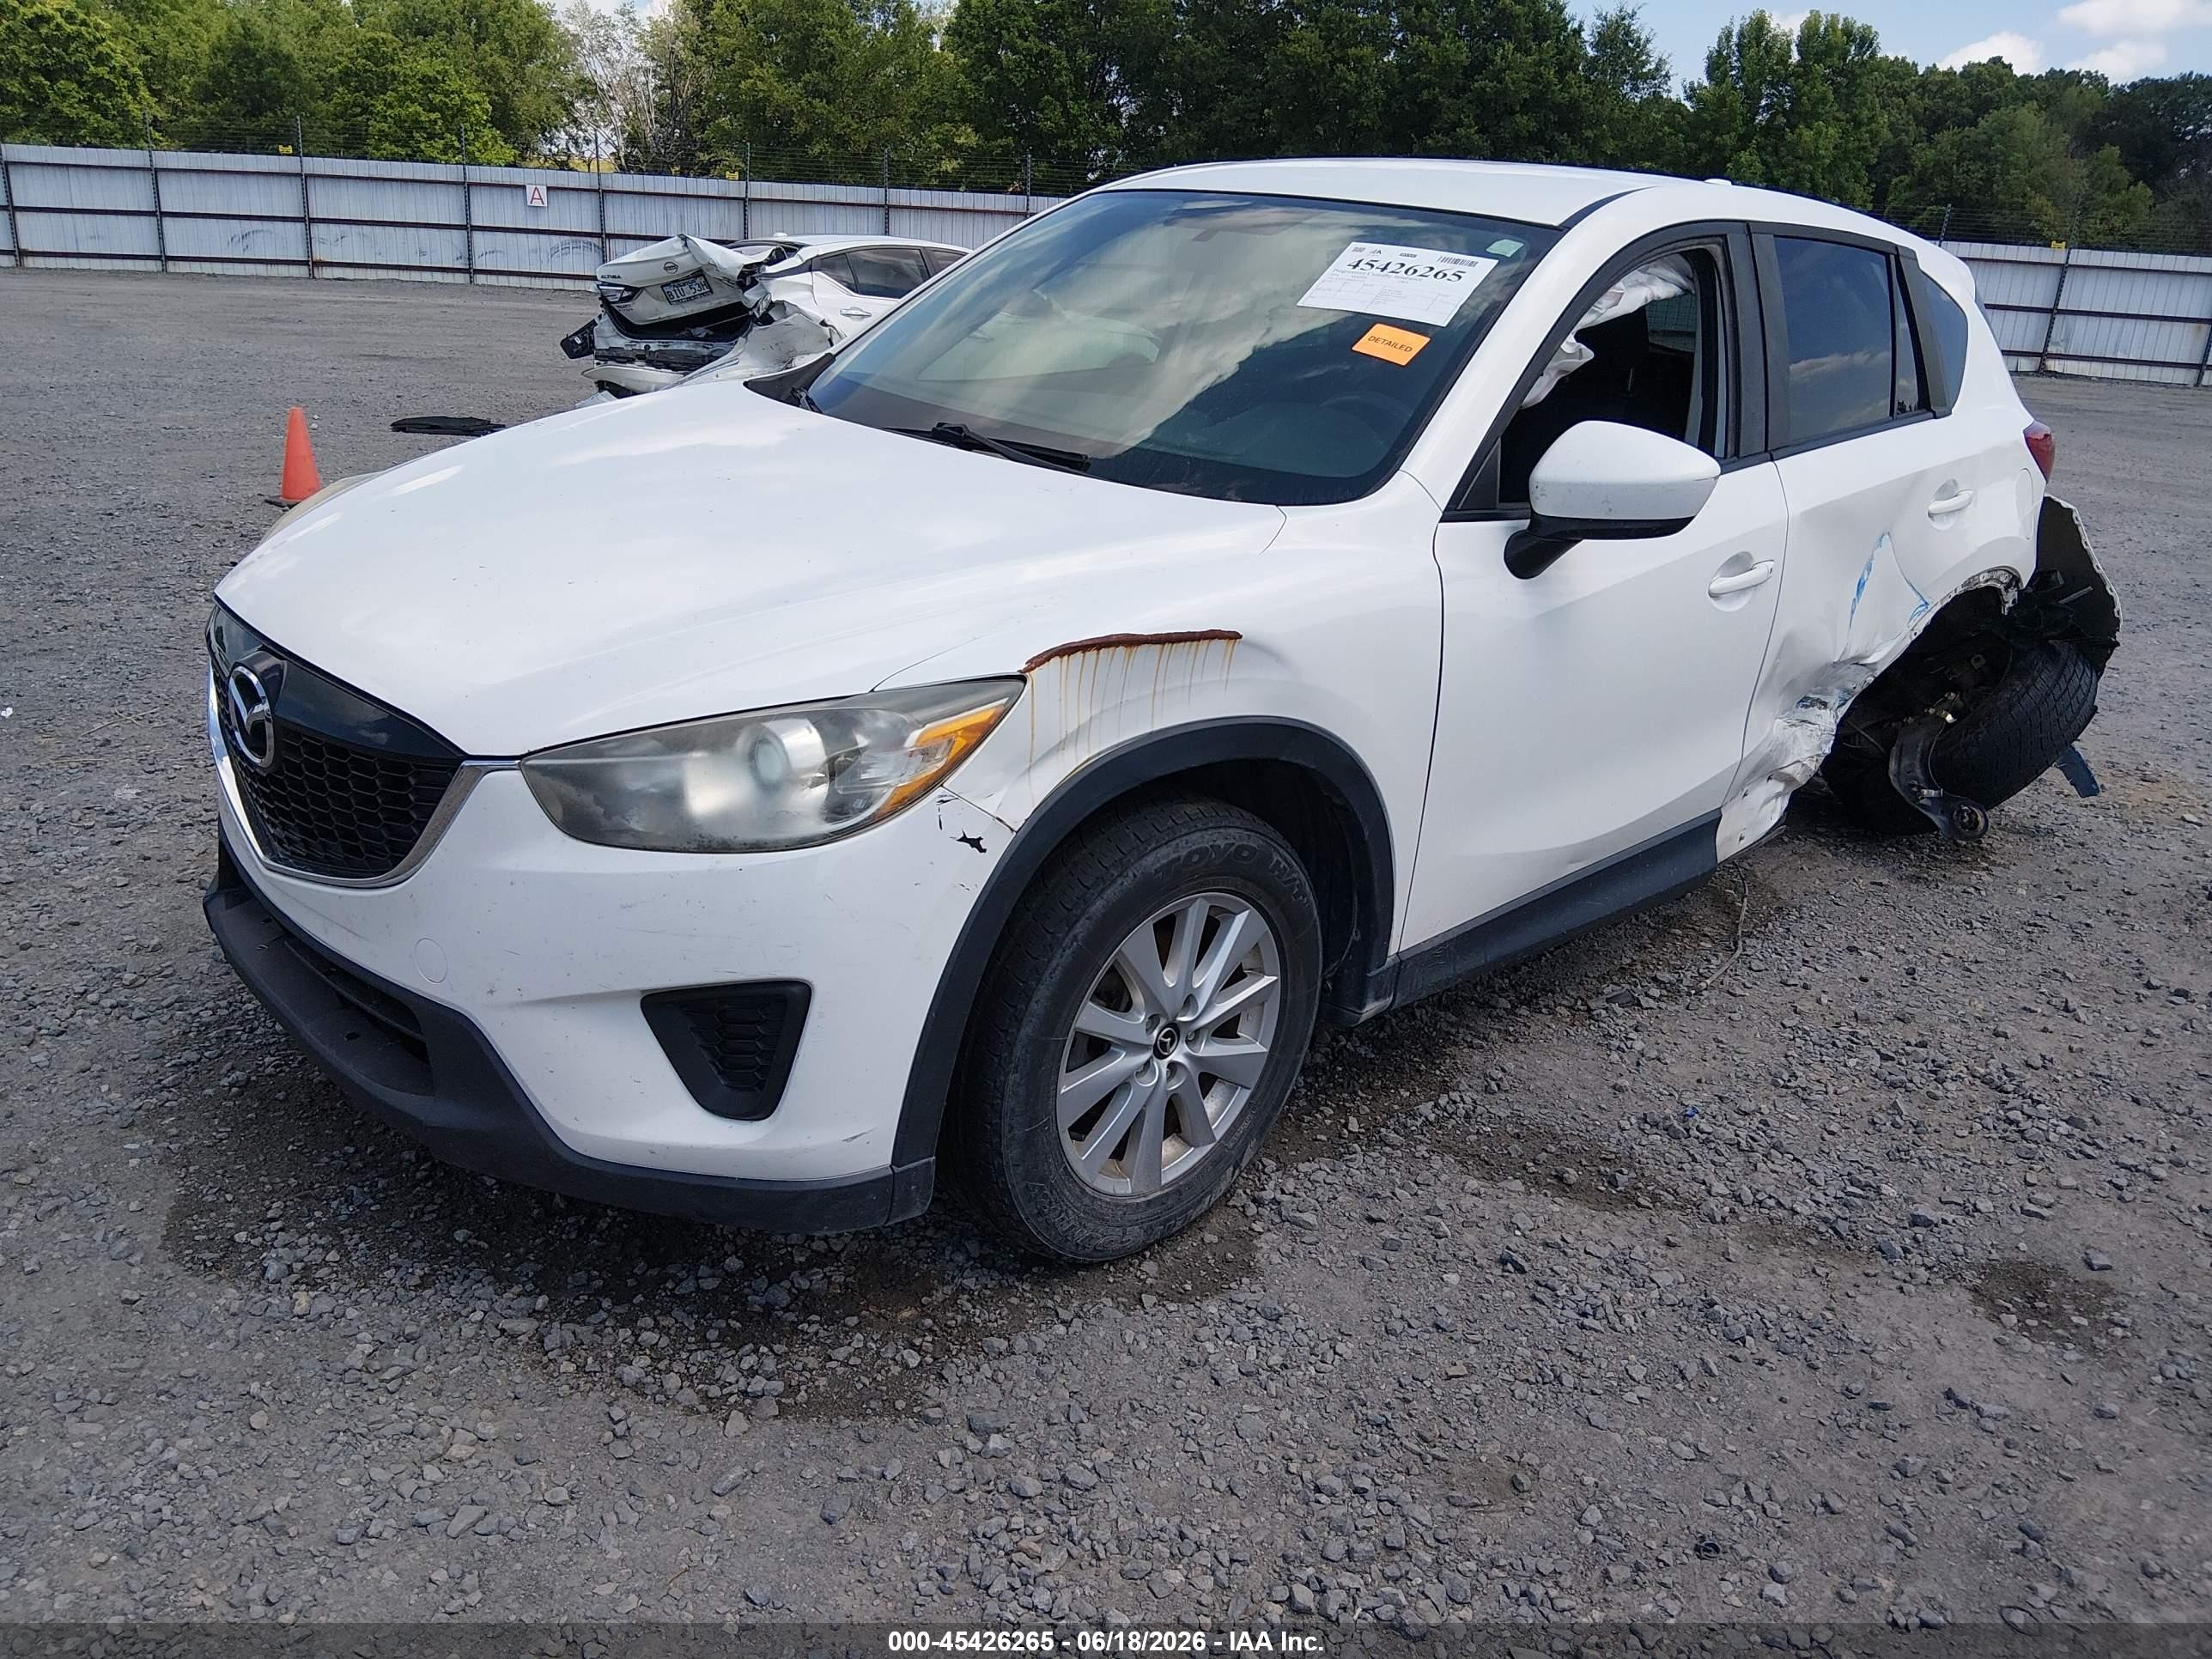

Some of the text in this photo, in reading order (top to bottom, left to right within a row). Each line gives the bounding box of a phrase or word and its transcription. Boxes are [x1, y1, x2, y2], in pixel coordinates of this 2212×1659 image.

[529, 185, 545, 205] A
[1346, 258, 1467, 283] 45426265
[1367, 335, 1413, 352] DETAILED
[1154, 842, 1260, 879] TOYO
